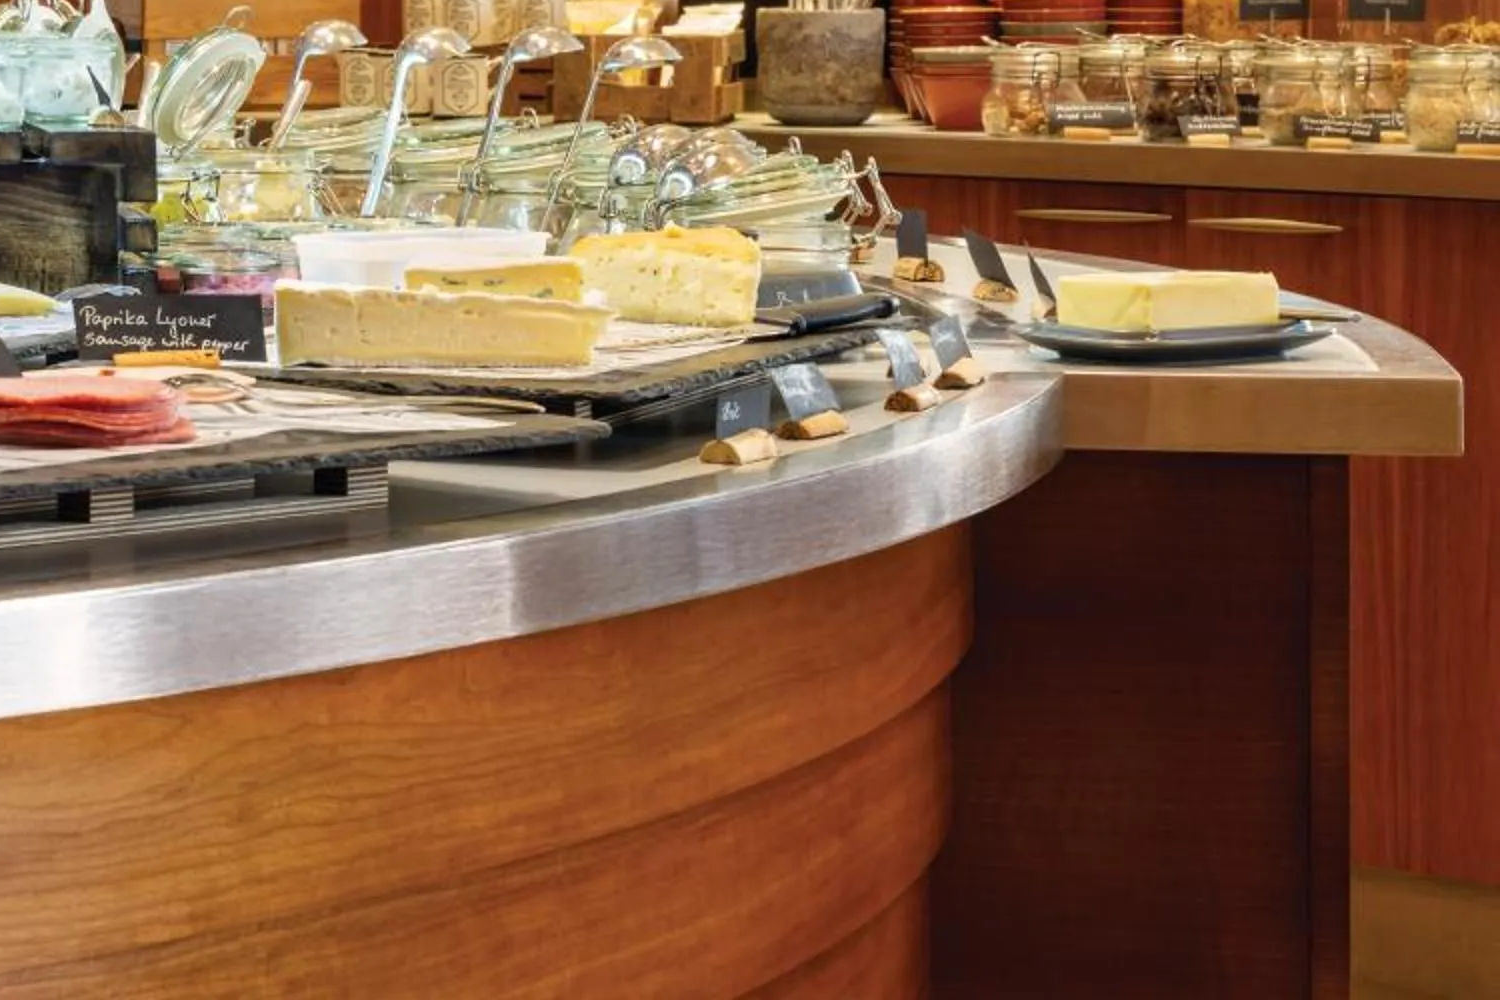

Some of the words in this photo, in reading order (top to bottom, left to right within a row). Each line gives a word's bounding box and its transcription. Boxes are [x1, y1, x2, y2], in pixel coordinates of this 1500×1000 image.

[79, 304, 149, 333] Paprika
[156, 306, 217, 339] Lyoner
[161, 332, 197, 350] with
